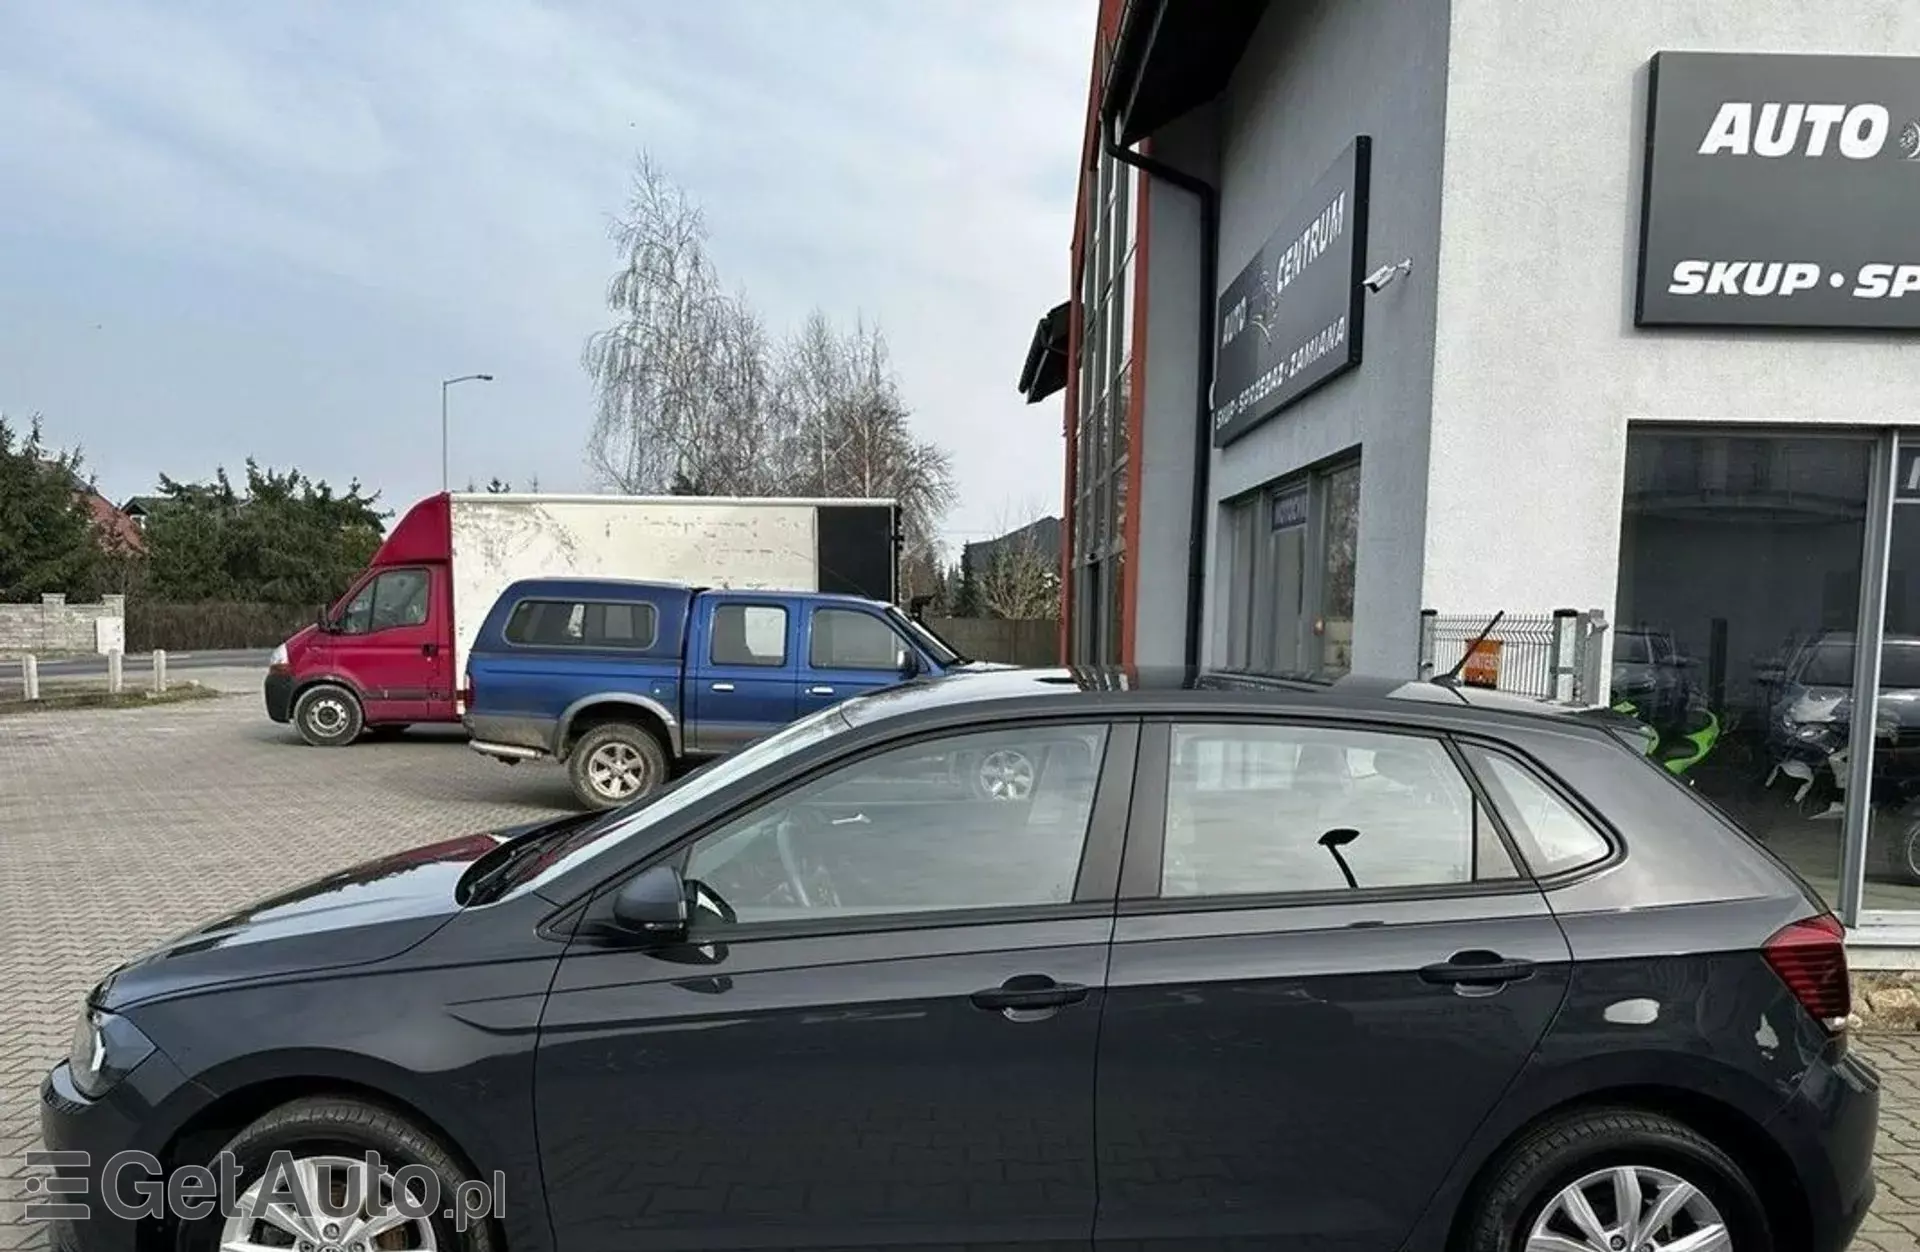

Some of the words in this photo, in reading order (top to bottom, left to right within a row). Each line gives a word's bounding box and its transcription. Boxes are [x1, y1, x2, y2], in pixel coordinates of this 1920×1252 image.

[1698, 102, 1890, 160] AUTO
[1276, 190, 1345, 294] CENTRUM
[1668, 260, 1820, 296] SKUP
